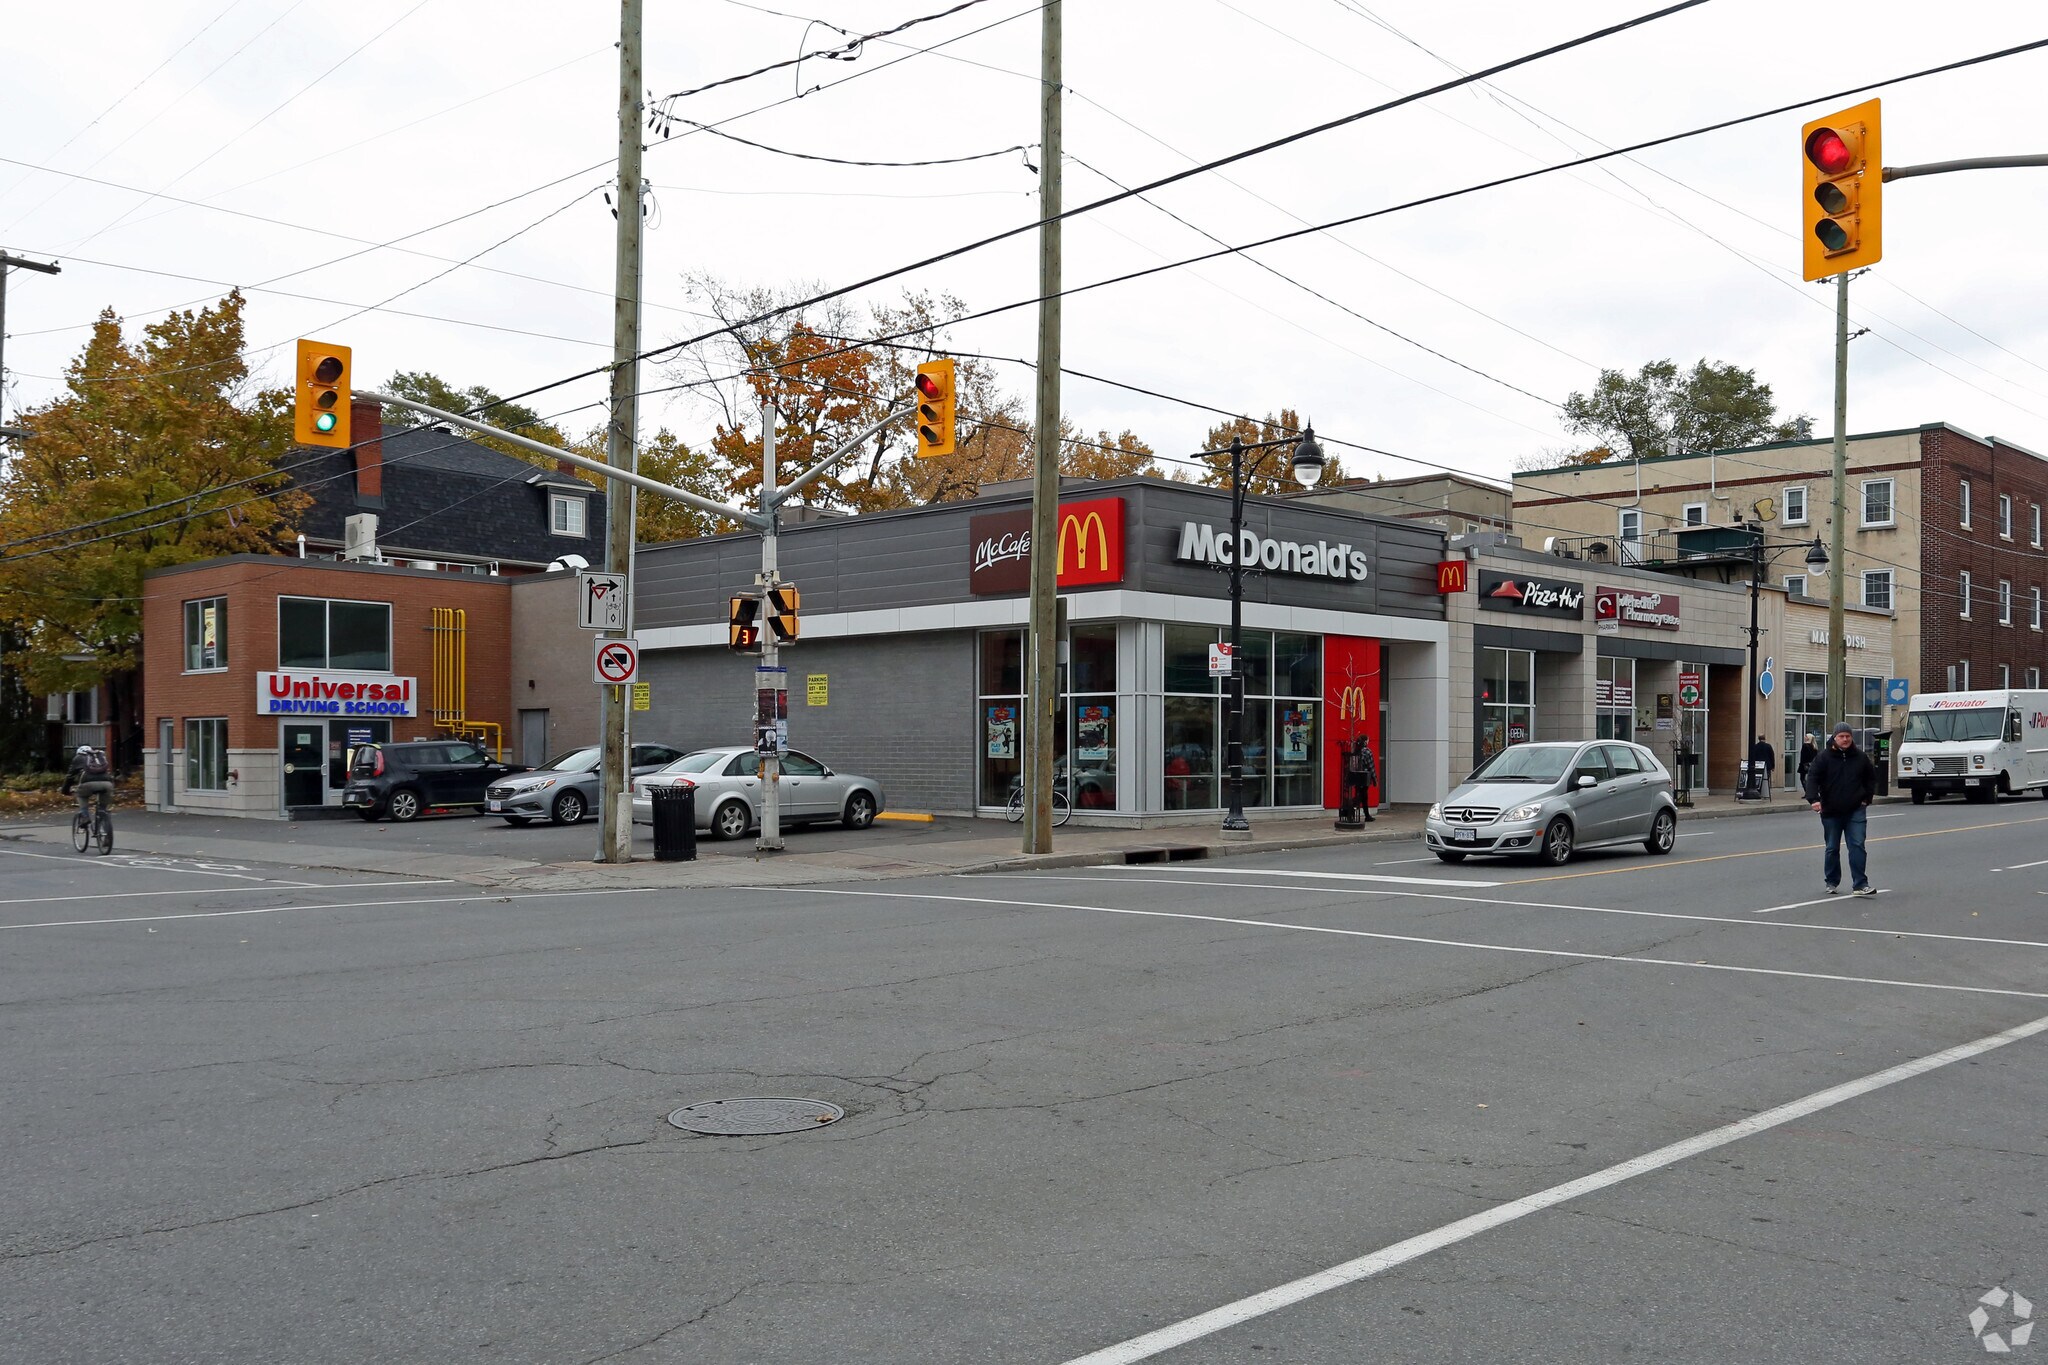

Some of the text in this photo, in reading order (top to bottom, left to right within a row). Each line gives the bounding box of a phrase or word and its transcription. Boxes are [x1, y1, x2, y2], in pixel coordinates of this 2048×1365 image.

[975, 530, 1031, 570] McCafé
[1177, 521, 1368, 581] McDonald's
[1523, 581, 1584, 609] Pizza Hut
[1626, 607, 1662, 626] Pharmacy
[742, 629, 749, 645] 3
[269, 675, 410, 701] Universal
[269, 699, 409, 715] DRIVING SCHOOL
[1938, 700, 1987, 708] Purolator
[1510, 727, 1525, 739] OPEN
